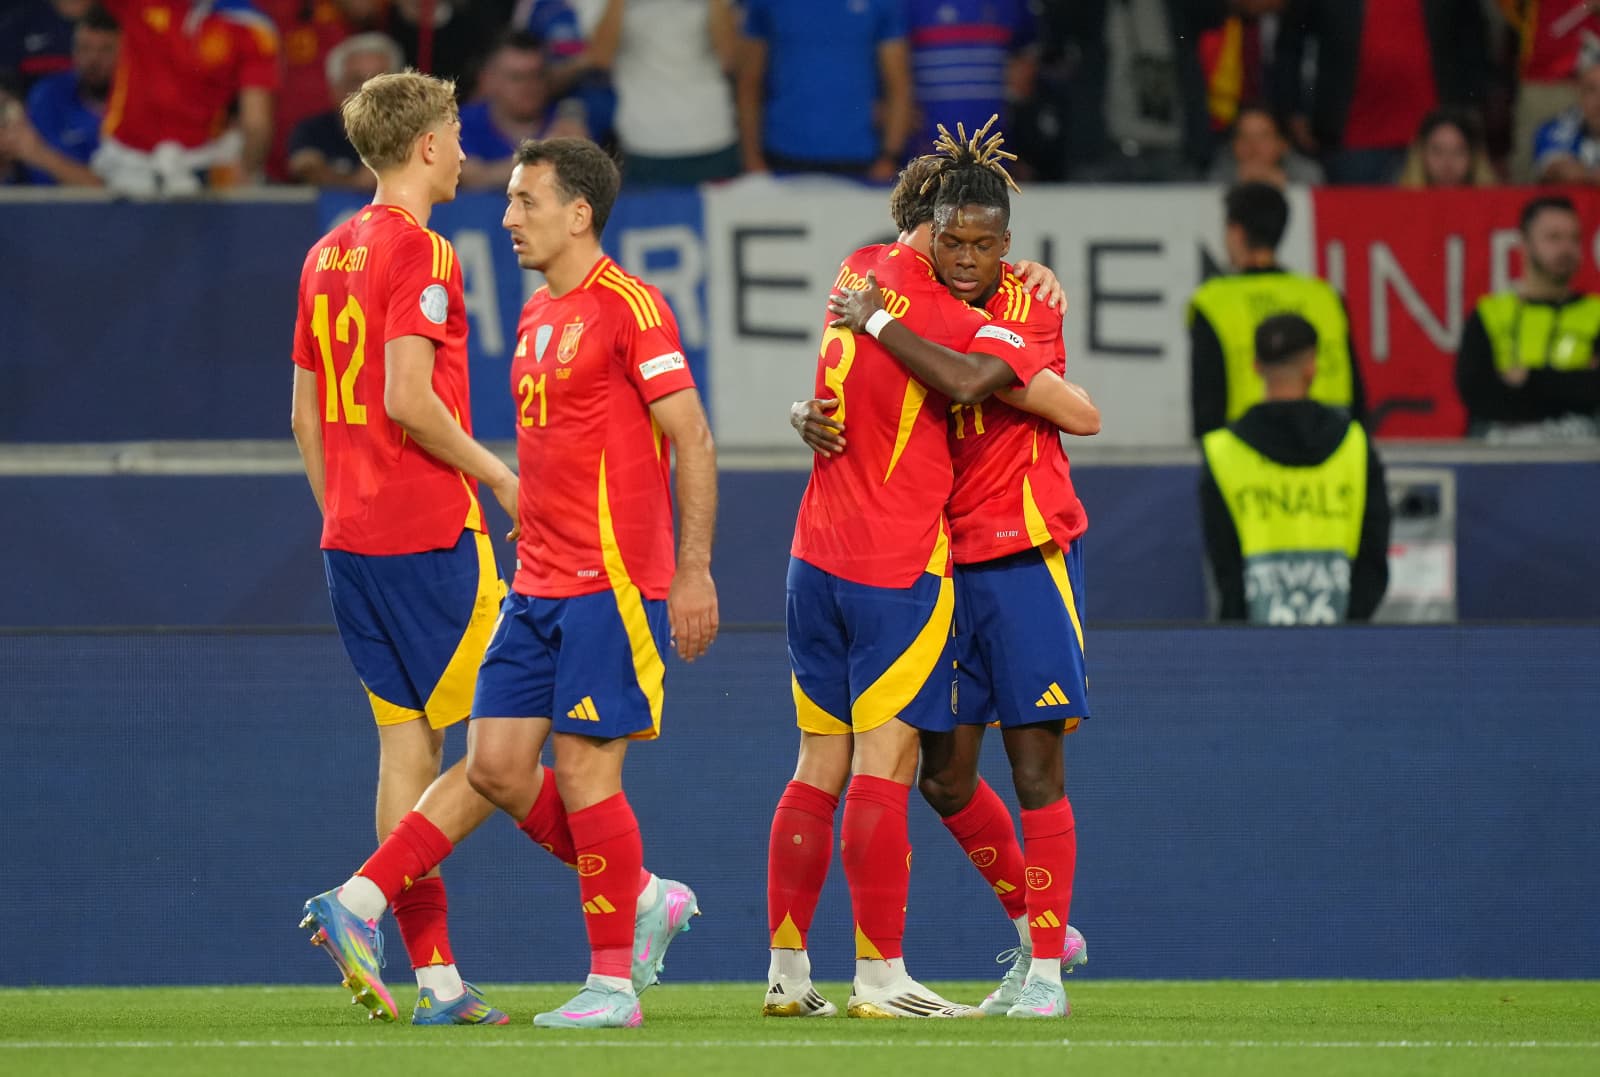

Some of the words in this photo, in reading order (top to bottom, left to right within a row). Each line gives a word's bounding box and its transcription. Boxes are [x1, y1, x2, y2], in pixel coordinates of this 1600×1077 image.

[310, 294, 367, 425] 12
[518, 373, 548, 428] 21
[820, 325, 856, 436] 3
